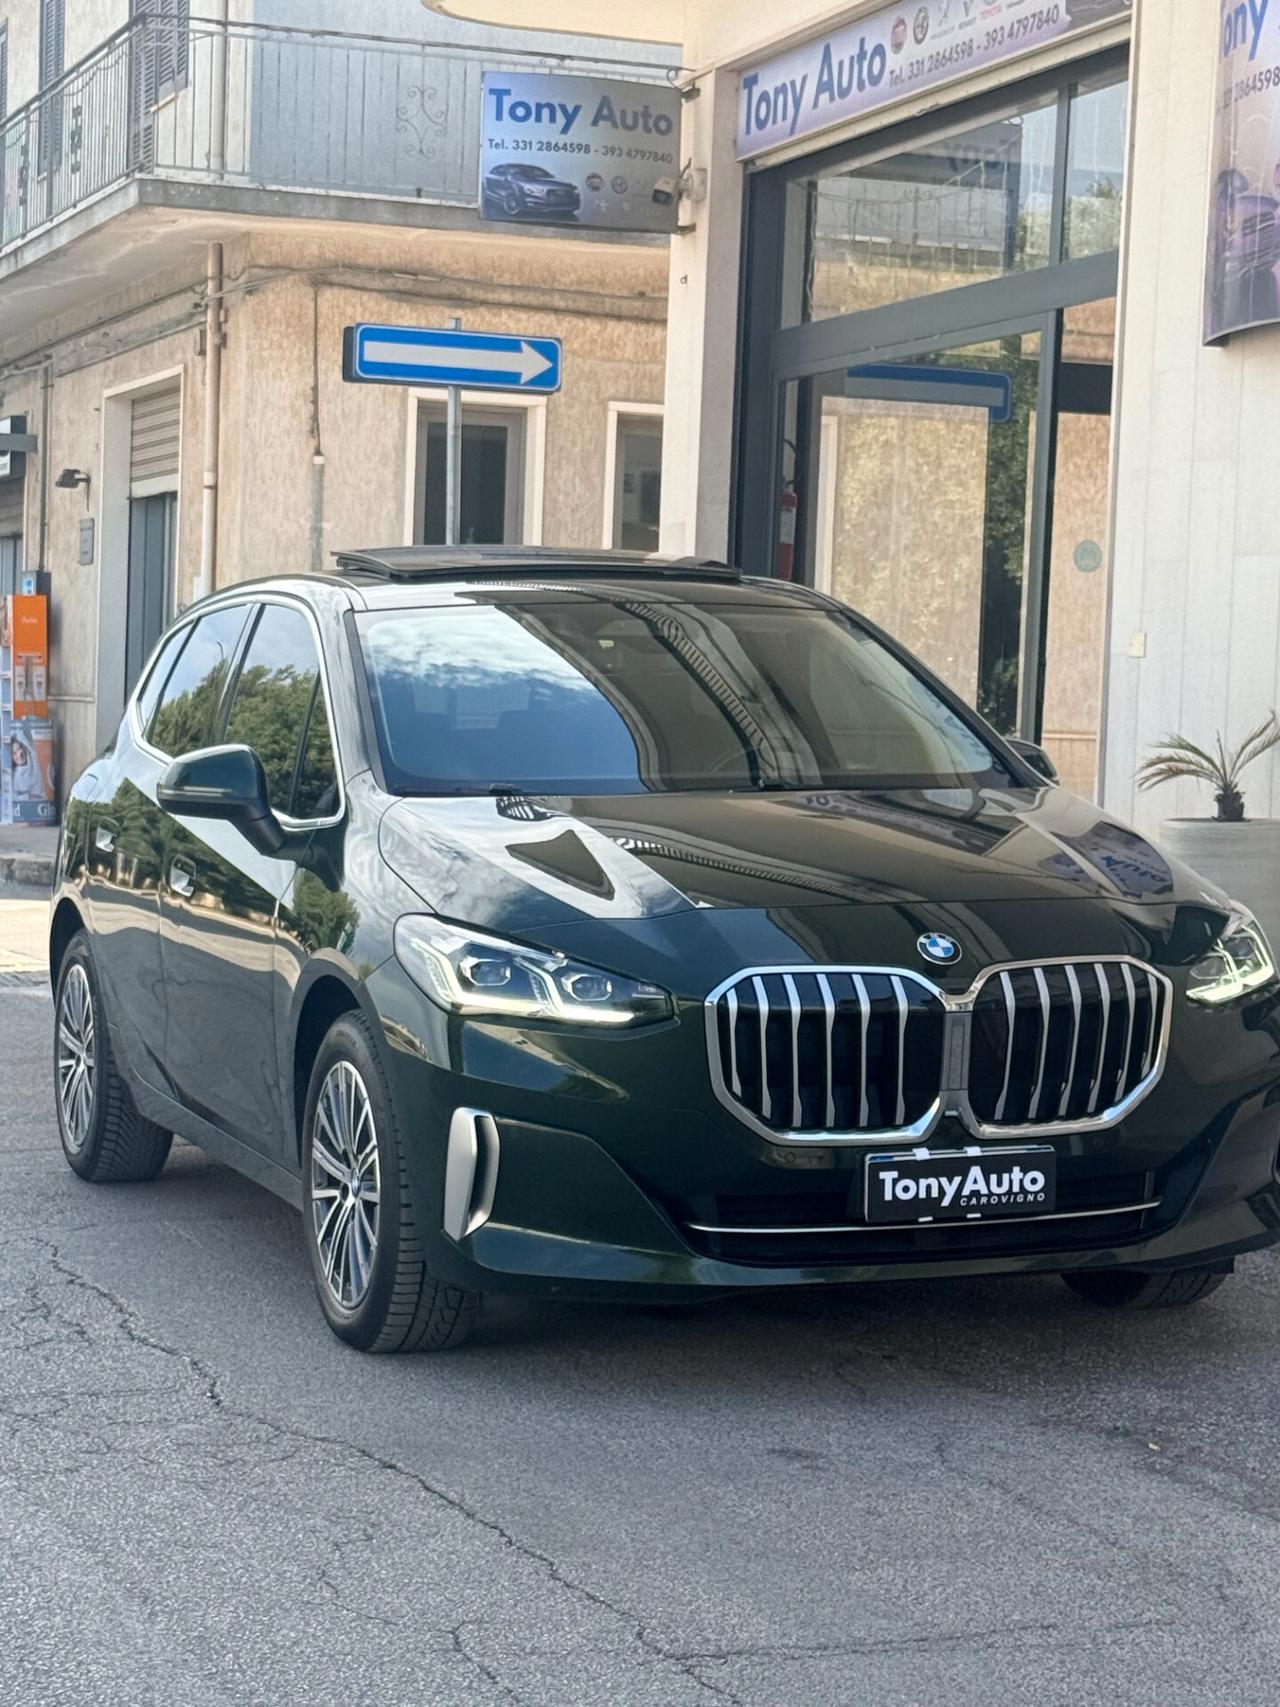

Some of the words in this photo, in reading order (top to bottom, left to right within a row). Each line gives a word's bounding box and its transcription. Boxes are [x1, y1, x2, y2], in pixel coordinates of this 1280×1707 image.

[888, 63, 905, 88] Tel.
[908, 58, 925, 81] 331
[927, 38, 974, 74] 2864598
[984, 26, 1004, 51] 393
[1007, 4, 1060, 41] 4797840
[743, 73, 808, 136] Tony
[812, 37, 887, 110] Auto
[488, 87, 583, 135] Tony
[590, 95, 674, 136] Auto
[488, 138, 508, 150] Tel.
[512, 139, 533, 151] 331
[536, 140, 591, 155] 2864598
[602, 145, 623, 158] 393
[625, 148, 673, 164] 4797840
[878, 1165, 1045, 1207] TonyAuto
[960, 1192, 1045, 1206] CAROVIGNO
